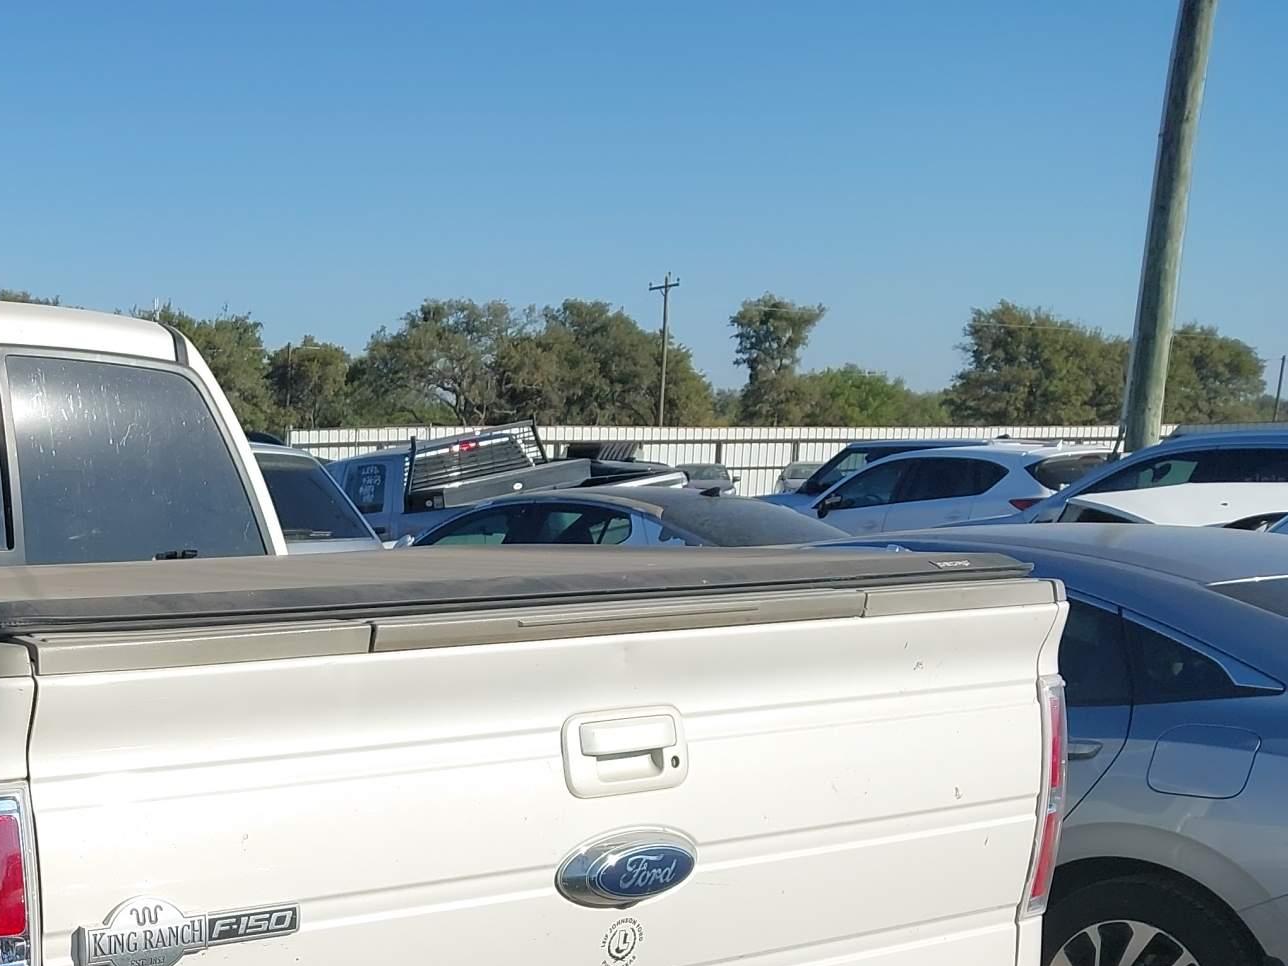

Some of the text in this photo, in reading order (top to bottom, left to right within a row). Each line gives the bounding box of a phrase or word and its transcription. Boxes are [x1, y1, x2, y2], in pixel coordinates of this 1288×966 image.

[620, 854, 677, 889] Ford
[92, 919, 204, 957] KING RANCH
[213, 910, 293, 938] F-150
